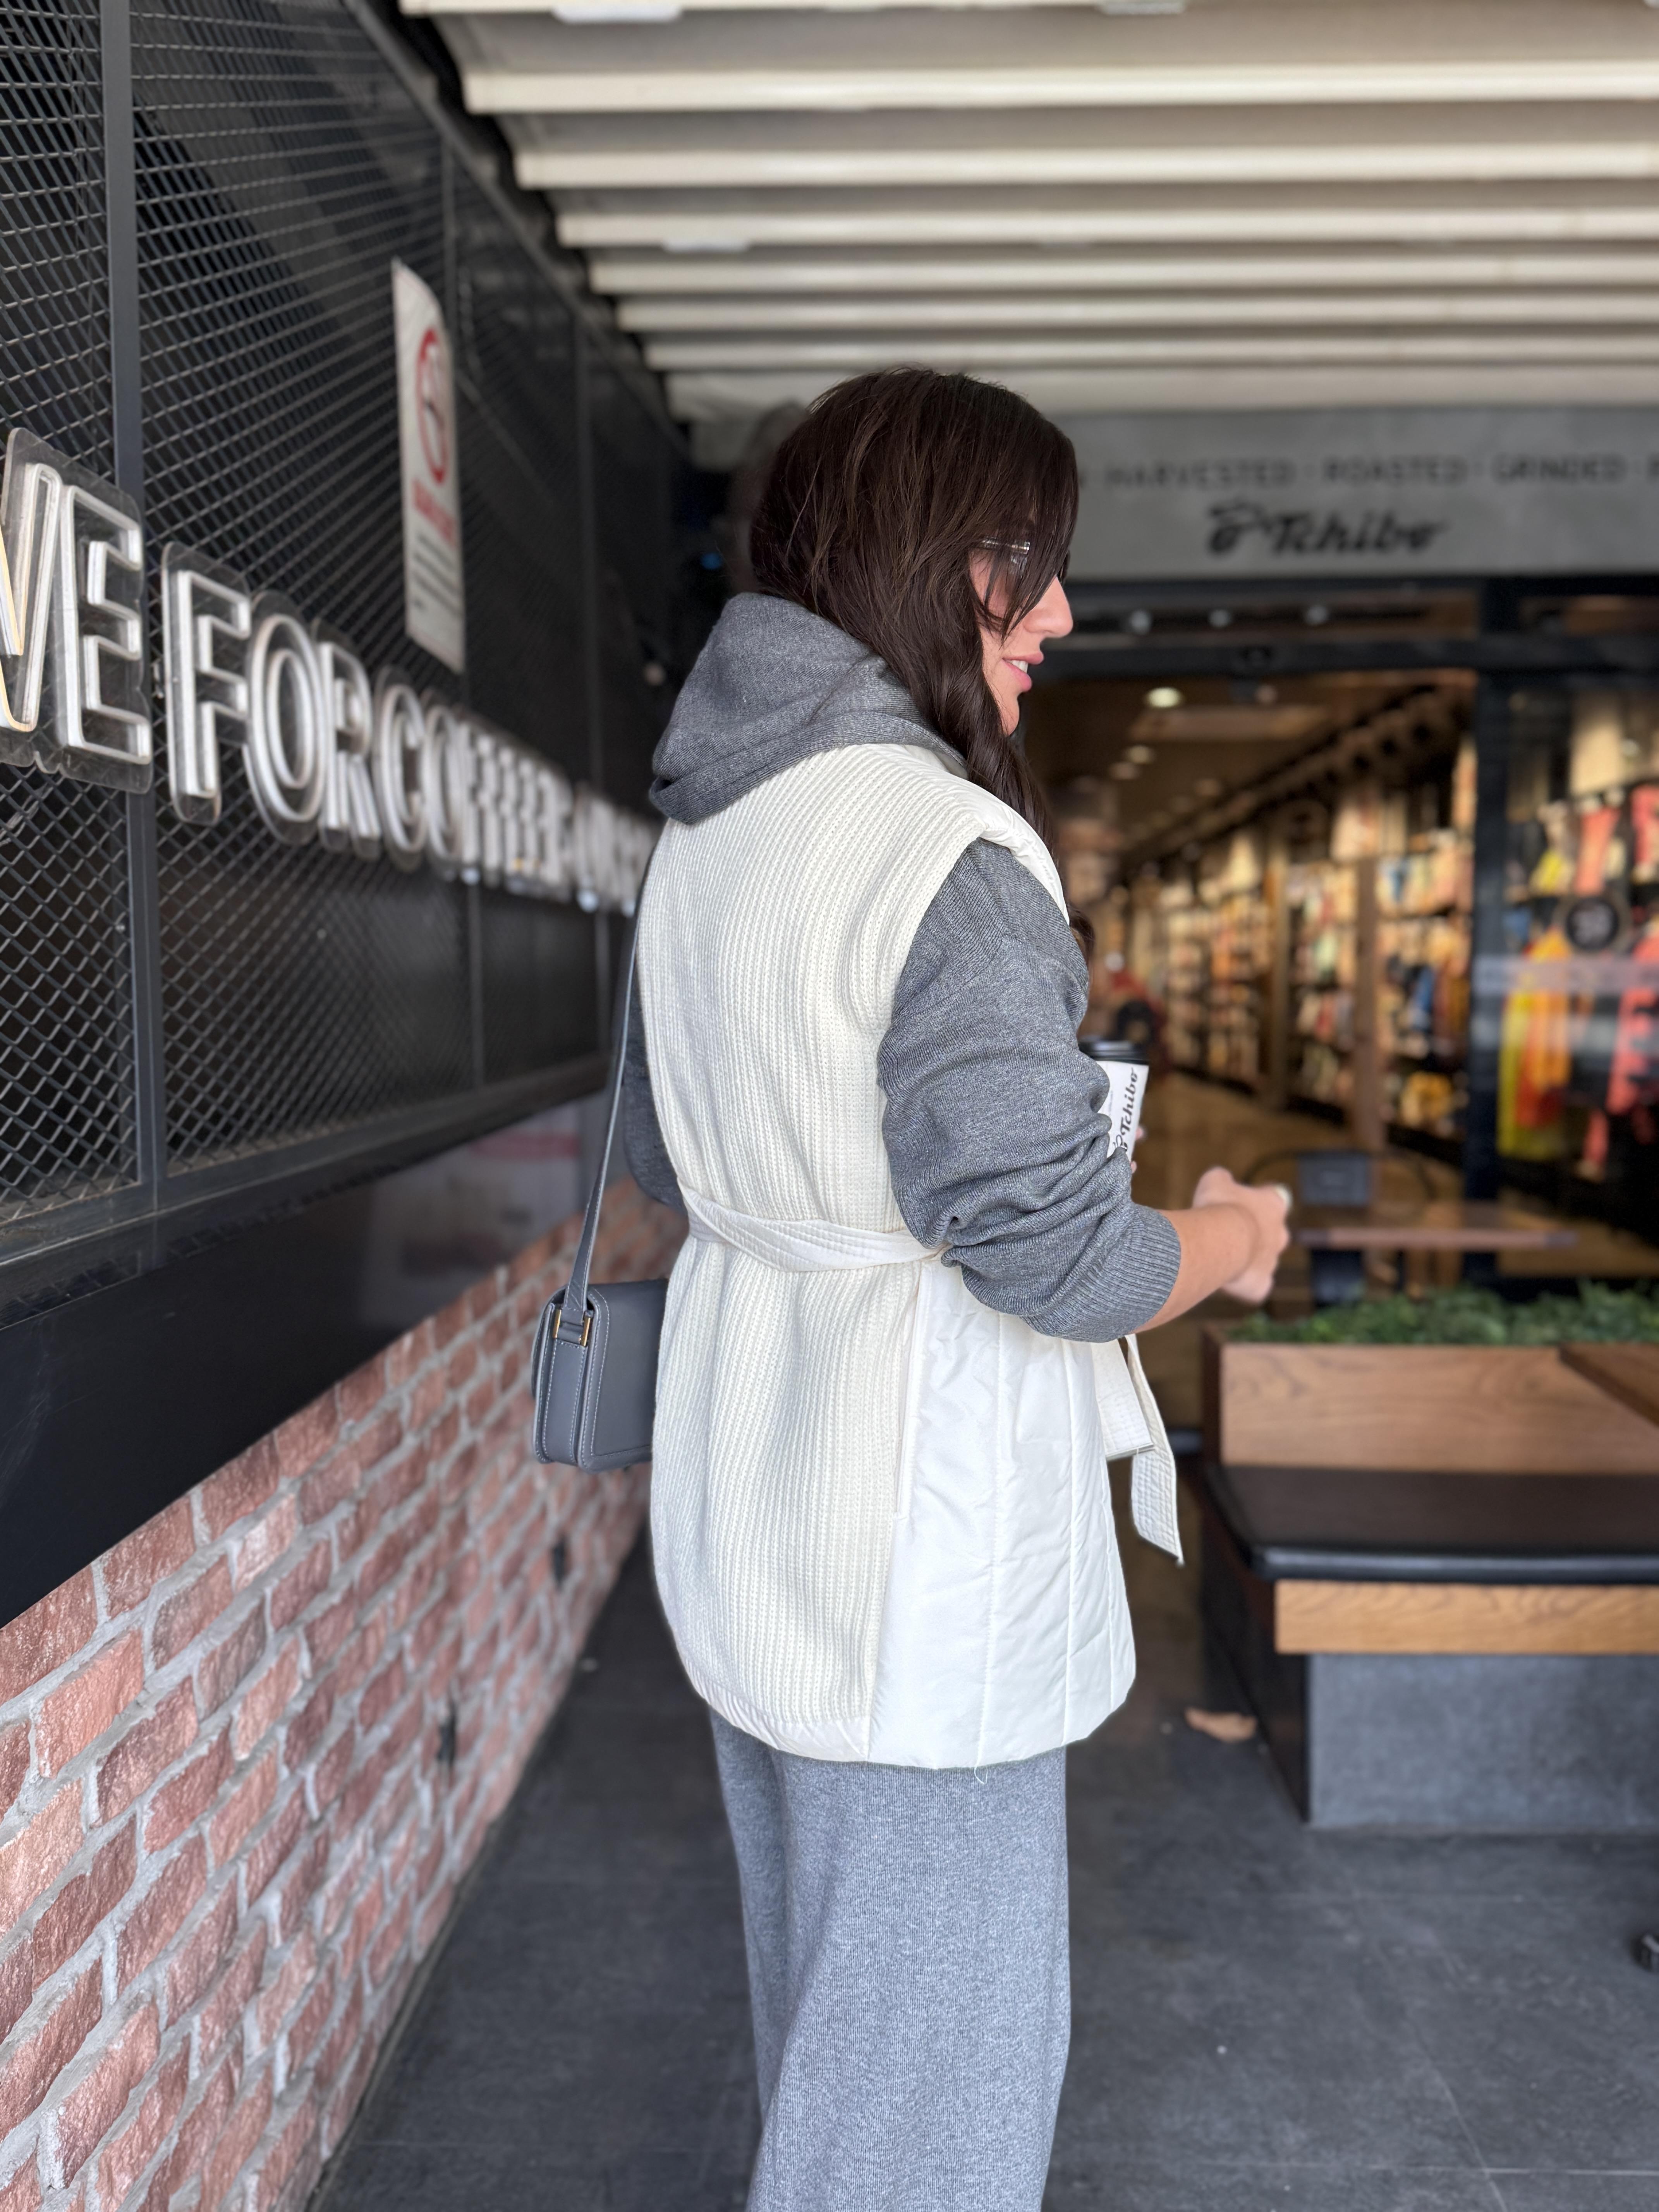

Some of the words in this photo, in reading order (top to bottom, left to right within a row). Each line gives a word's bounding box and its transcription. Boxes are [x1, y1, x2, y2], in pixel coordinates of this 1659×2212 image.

[1323, 456, 1468, 486] ROASTED
[1269, 510, 1449, 555] Tchibo
[1120, 1067, 1138, 1135] Tchibo
